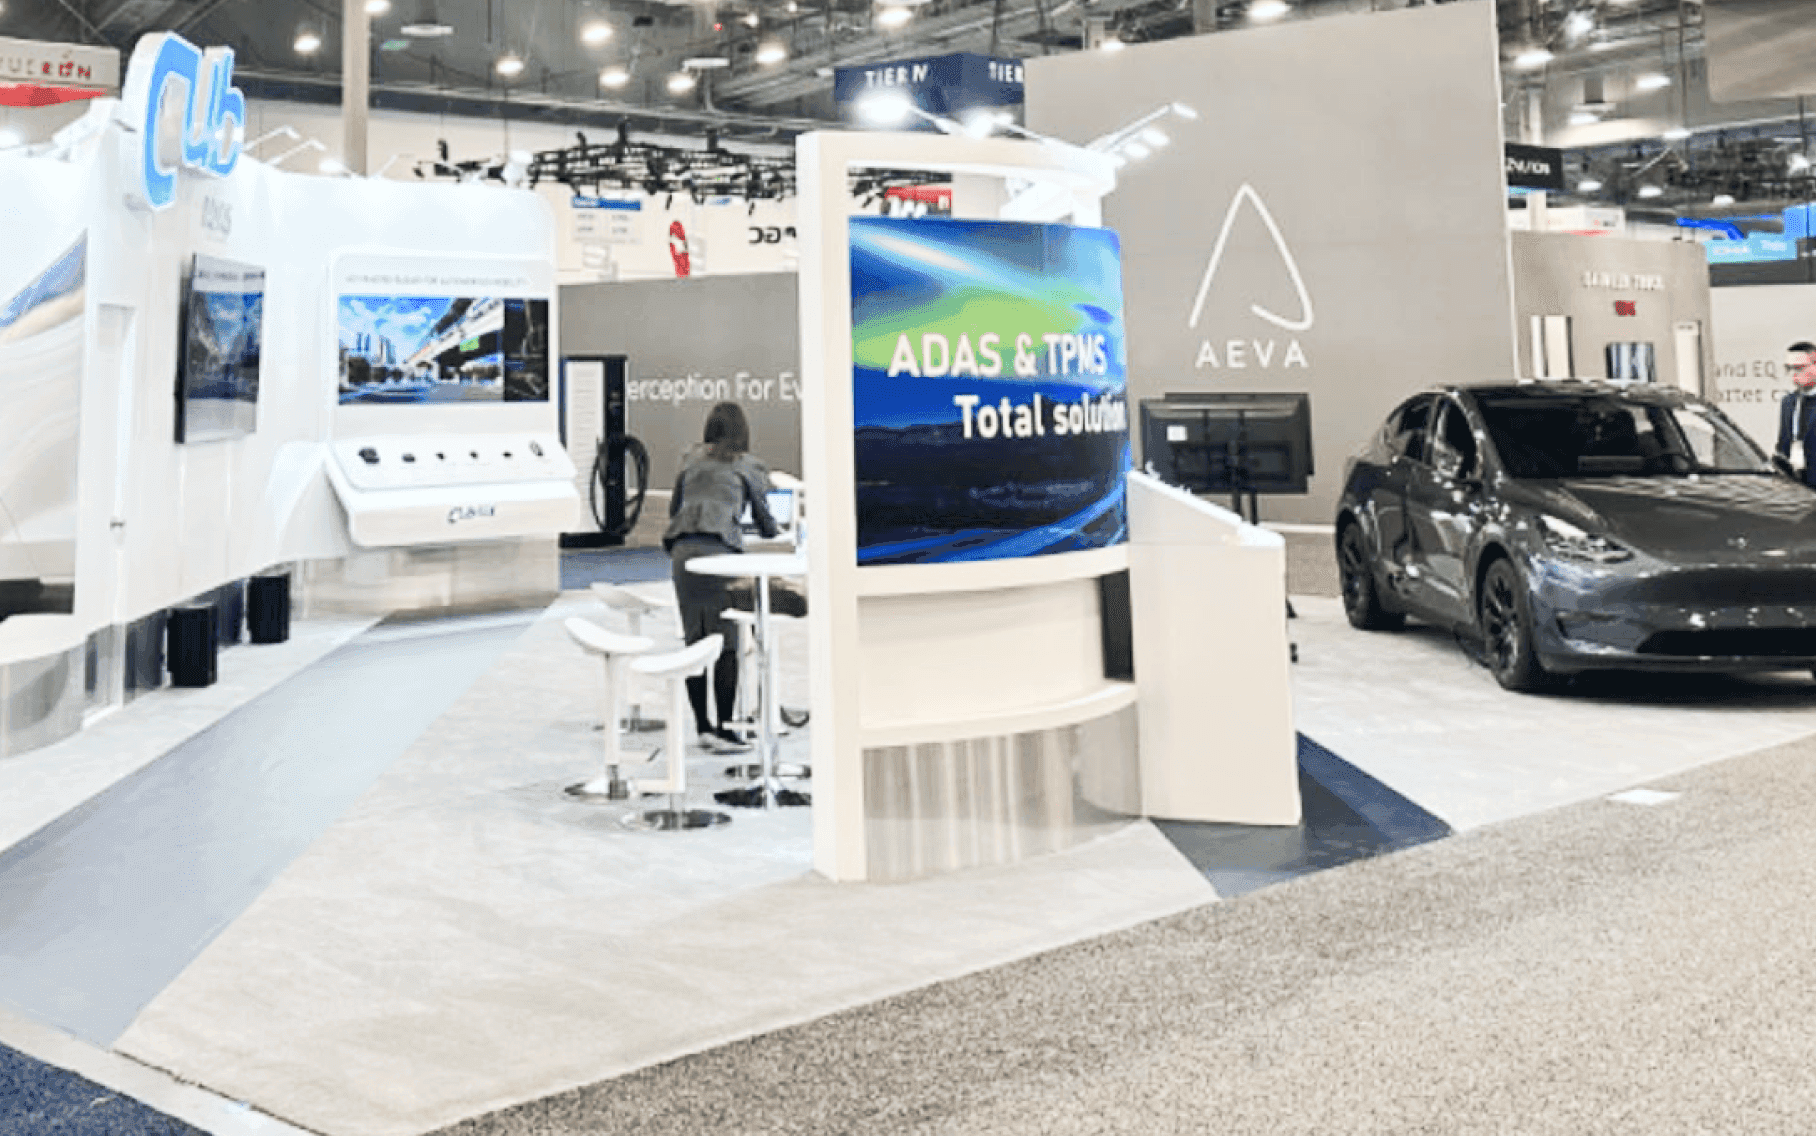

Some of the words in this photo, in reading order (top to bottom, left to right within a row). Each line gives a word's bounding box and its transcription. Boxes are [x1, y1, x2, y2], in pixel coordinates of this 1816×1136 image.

[865, 66, 908, 88] TIER
[887, 332, 1002, 378] ADAS
[1014, 332, 1038, 376] &
[1041, 332, 1107, 376] TPMS
[1195, 339, 1309, 369] AEVA
[627, 372, 730, 406] erception
[735, 372, 774, 401] For
[779, 372, 802, 401] Ev
[954, 392, 1045, 439] Total
